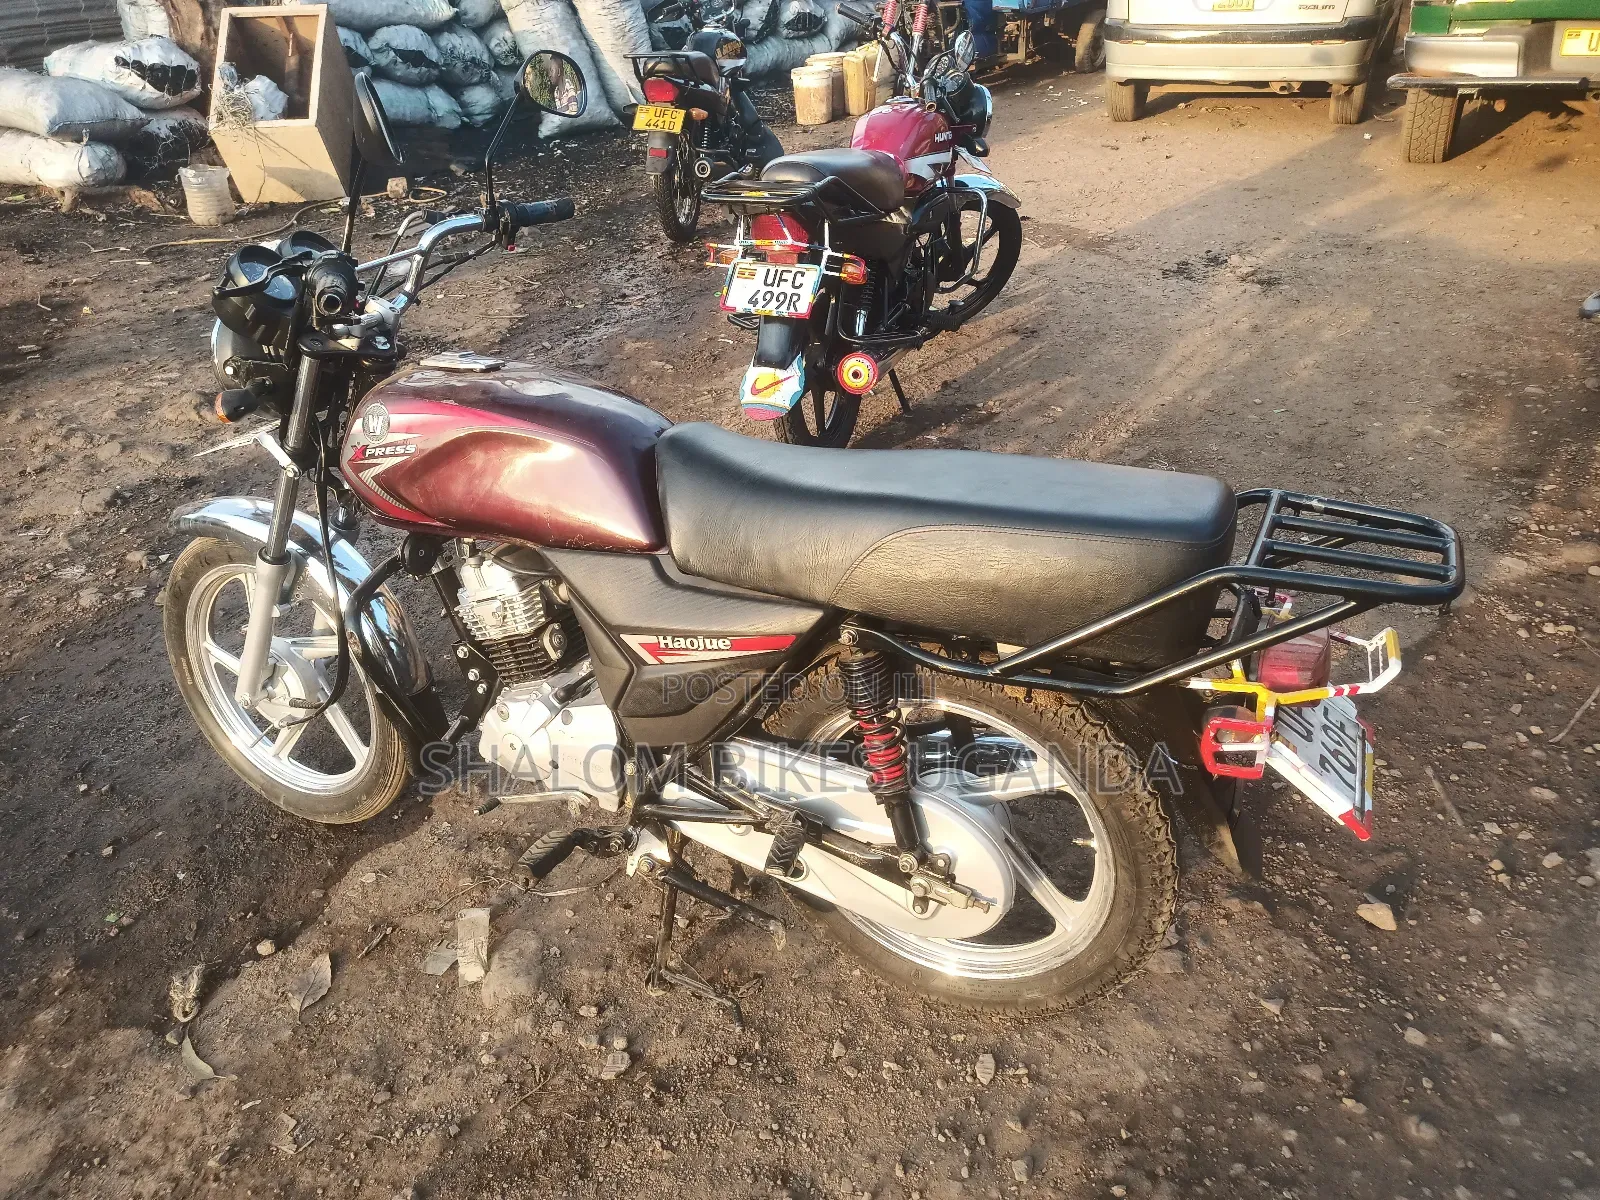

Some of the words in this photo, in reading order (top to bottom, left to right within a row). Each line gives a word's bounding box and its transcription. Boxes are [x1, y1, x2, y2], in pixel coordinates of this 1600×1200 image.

[654, 108, 678, 119] UFC
[763, 268, 806, 290] UFC
[747, 289, 801, 312] 499R
[348, 444, 417, 461] XPRESS
[657, 635, 732, 651] Haojue
[1277, 703, 1316, 742] UF
